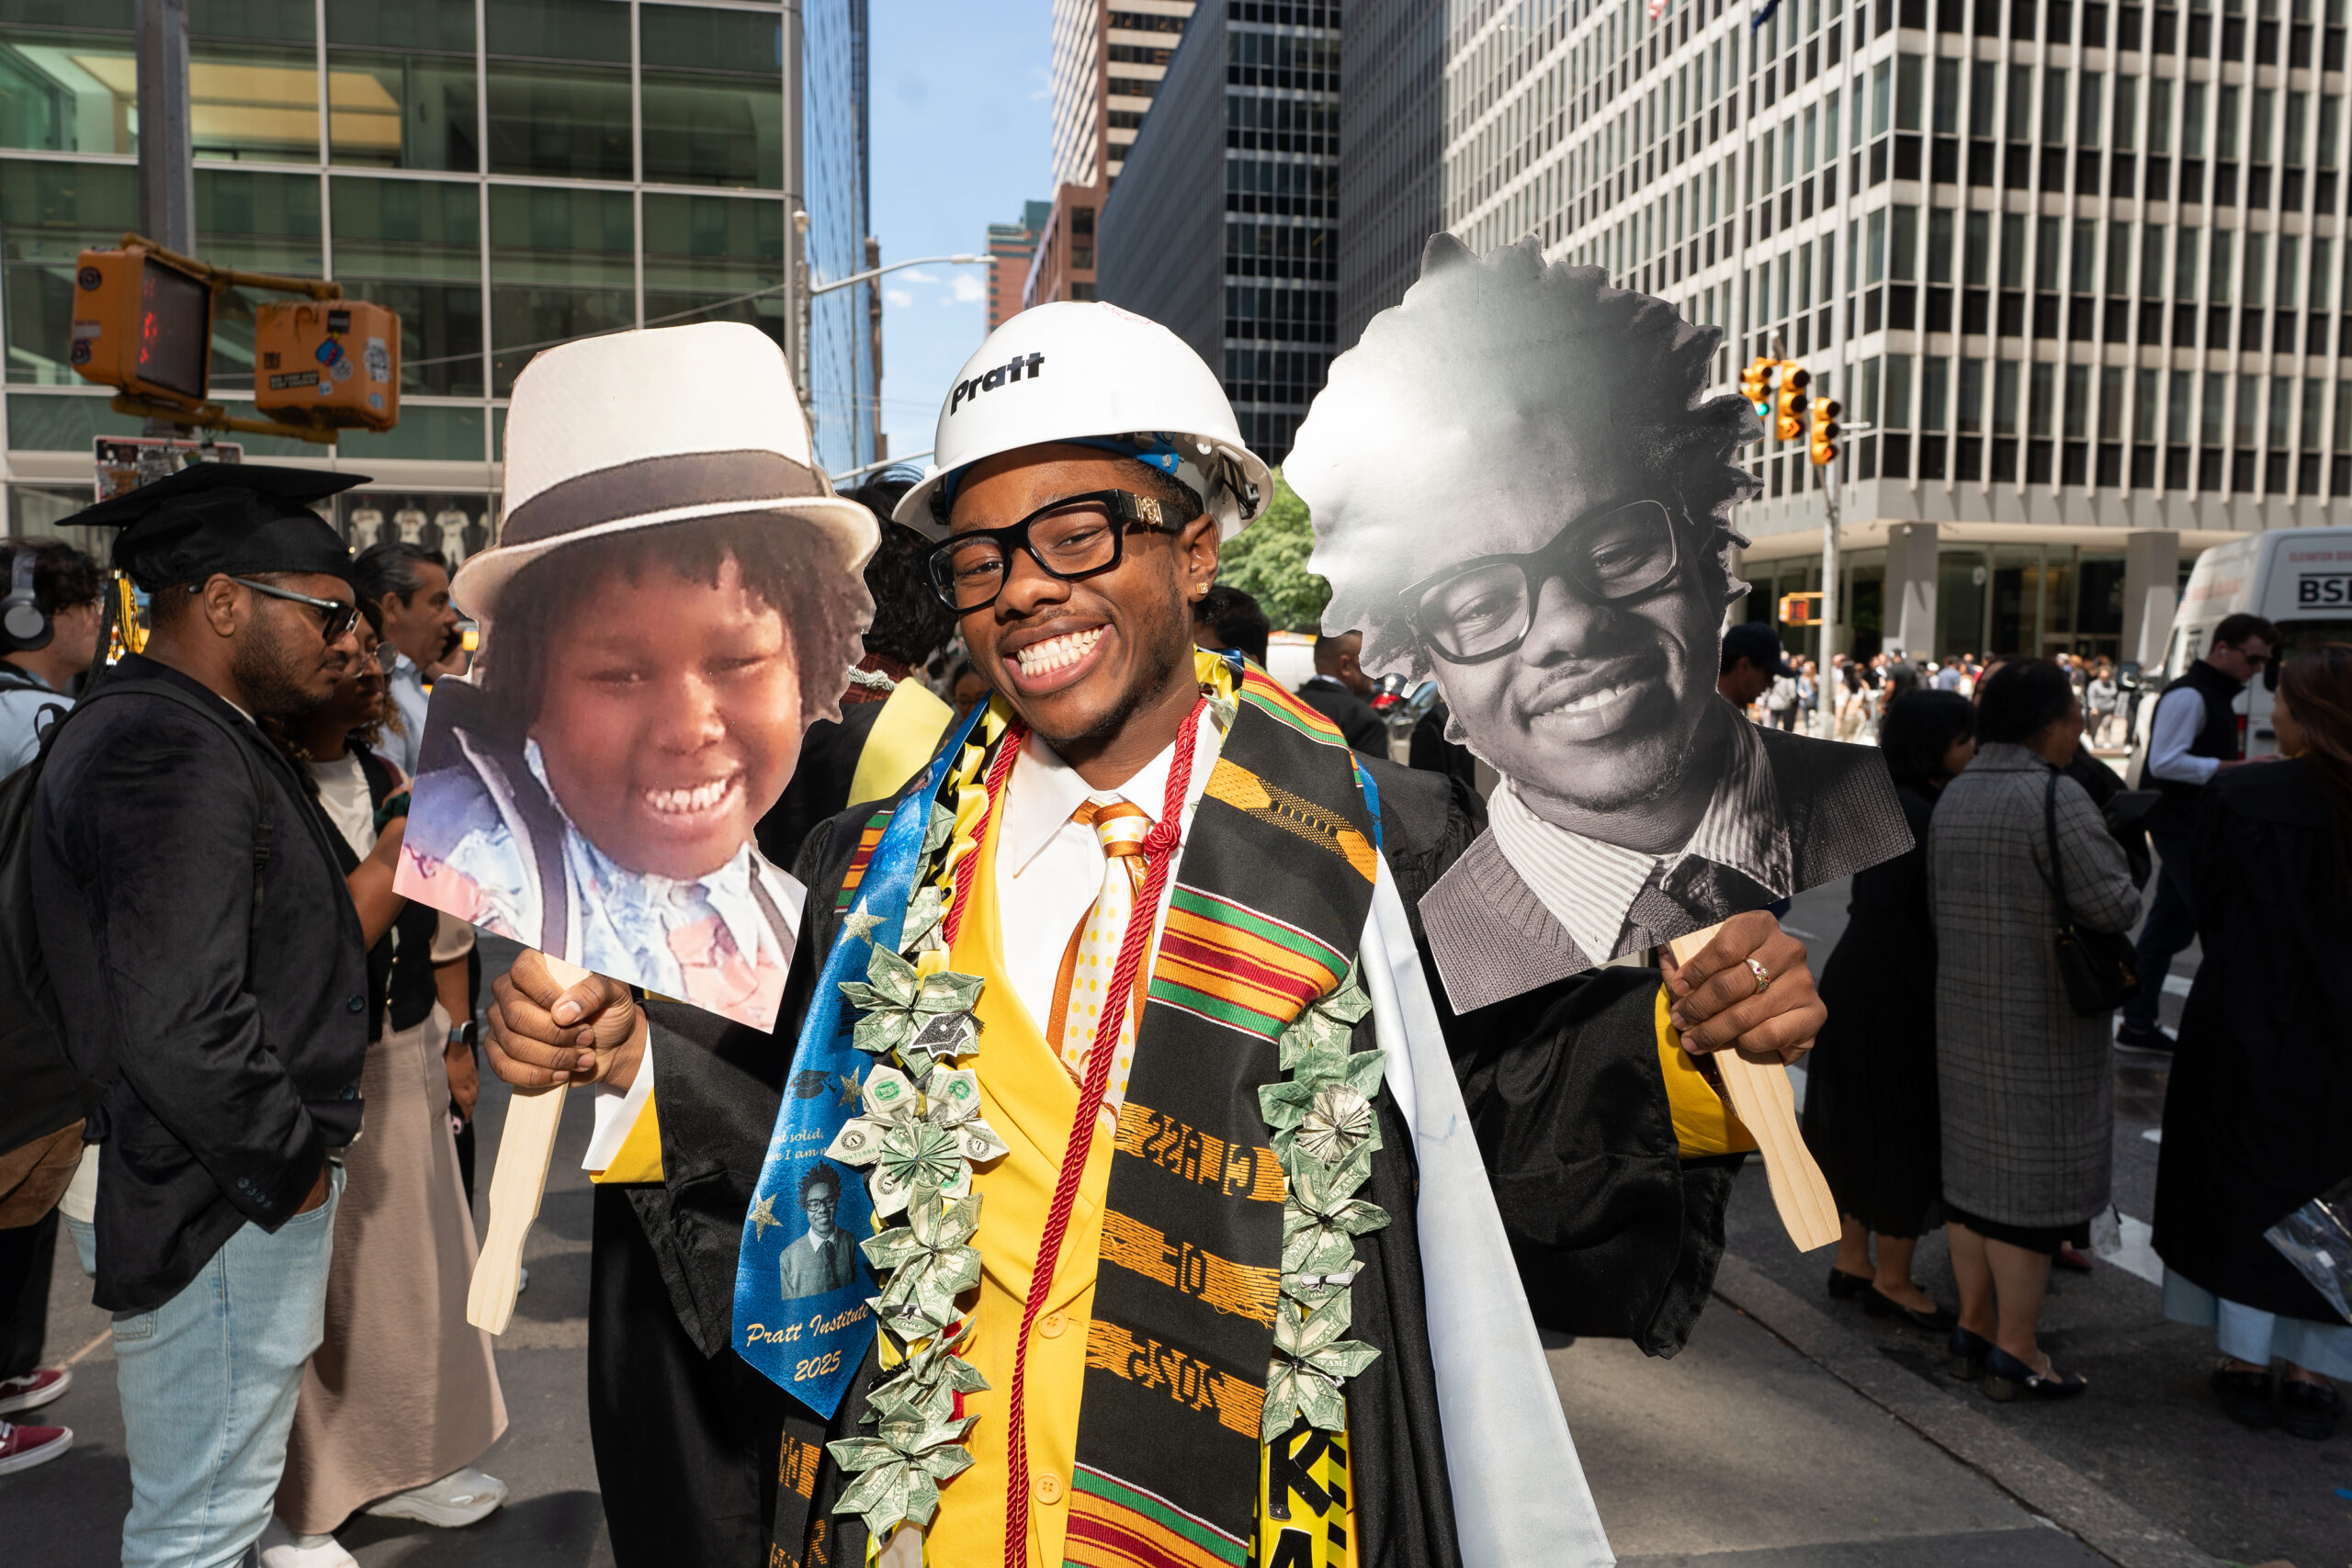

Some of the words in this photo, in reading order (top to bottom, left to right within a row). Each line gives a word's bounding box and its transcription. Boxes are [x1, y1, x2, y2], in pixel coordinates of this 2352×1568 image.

[950, 352, 1045, 416] Pratt
[2300, 580, 2352, 603] BS
[746, 1323, 803, 1348] Pratt
[808, 1303, 869, 1337] Institute
[794, 1349, 842, 1382] 2025
